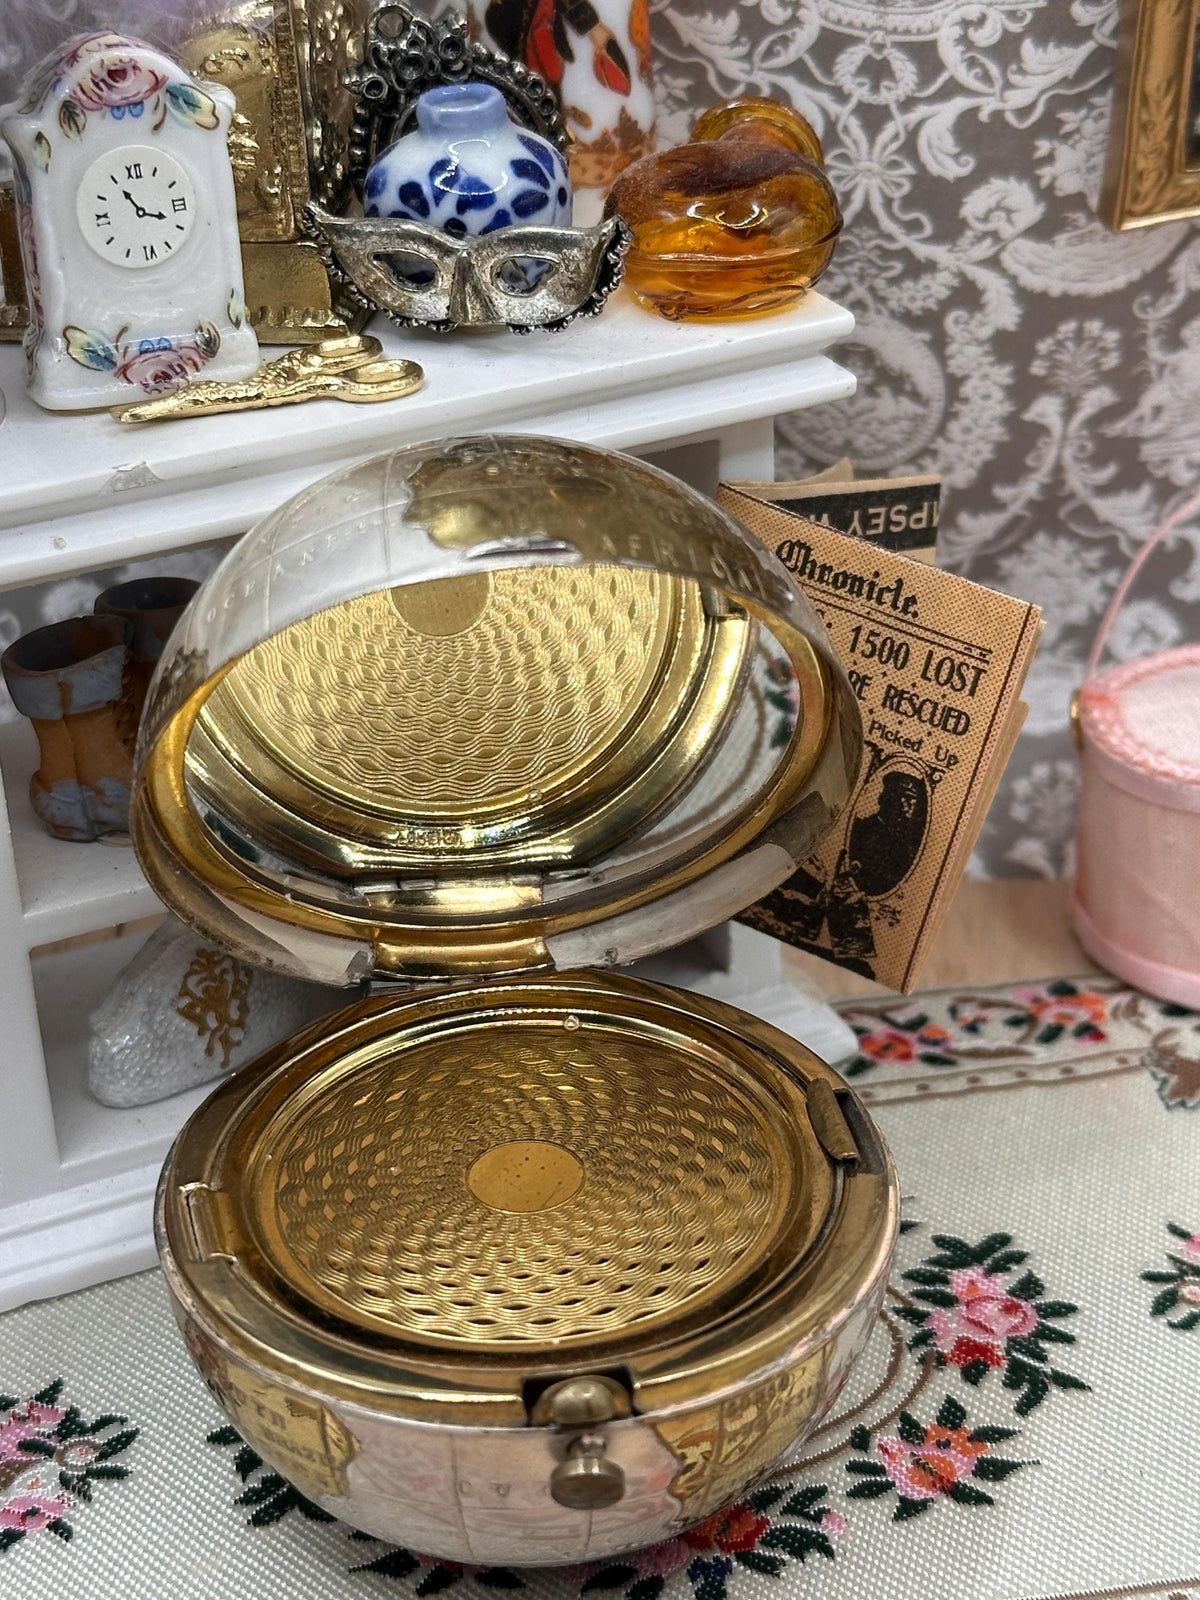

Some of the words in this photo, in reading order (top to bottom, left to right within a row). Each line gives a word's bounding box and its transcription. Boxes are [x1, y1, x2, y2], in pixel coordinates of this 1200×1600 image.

[125, 163, 144, 180] XII
[171, 197, 188, 213] III
[849, 625, 911, 671] 1500
[920, 649, 988, 698] LOST
[881, 684, 971, 737] RESCUED
[868, 719, 925, 752] Picked
[934, 744, 959, 767] Up
